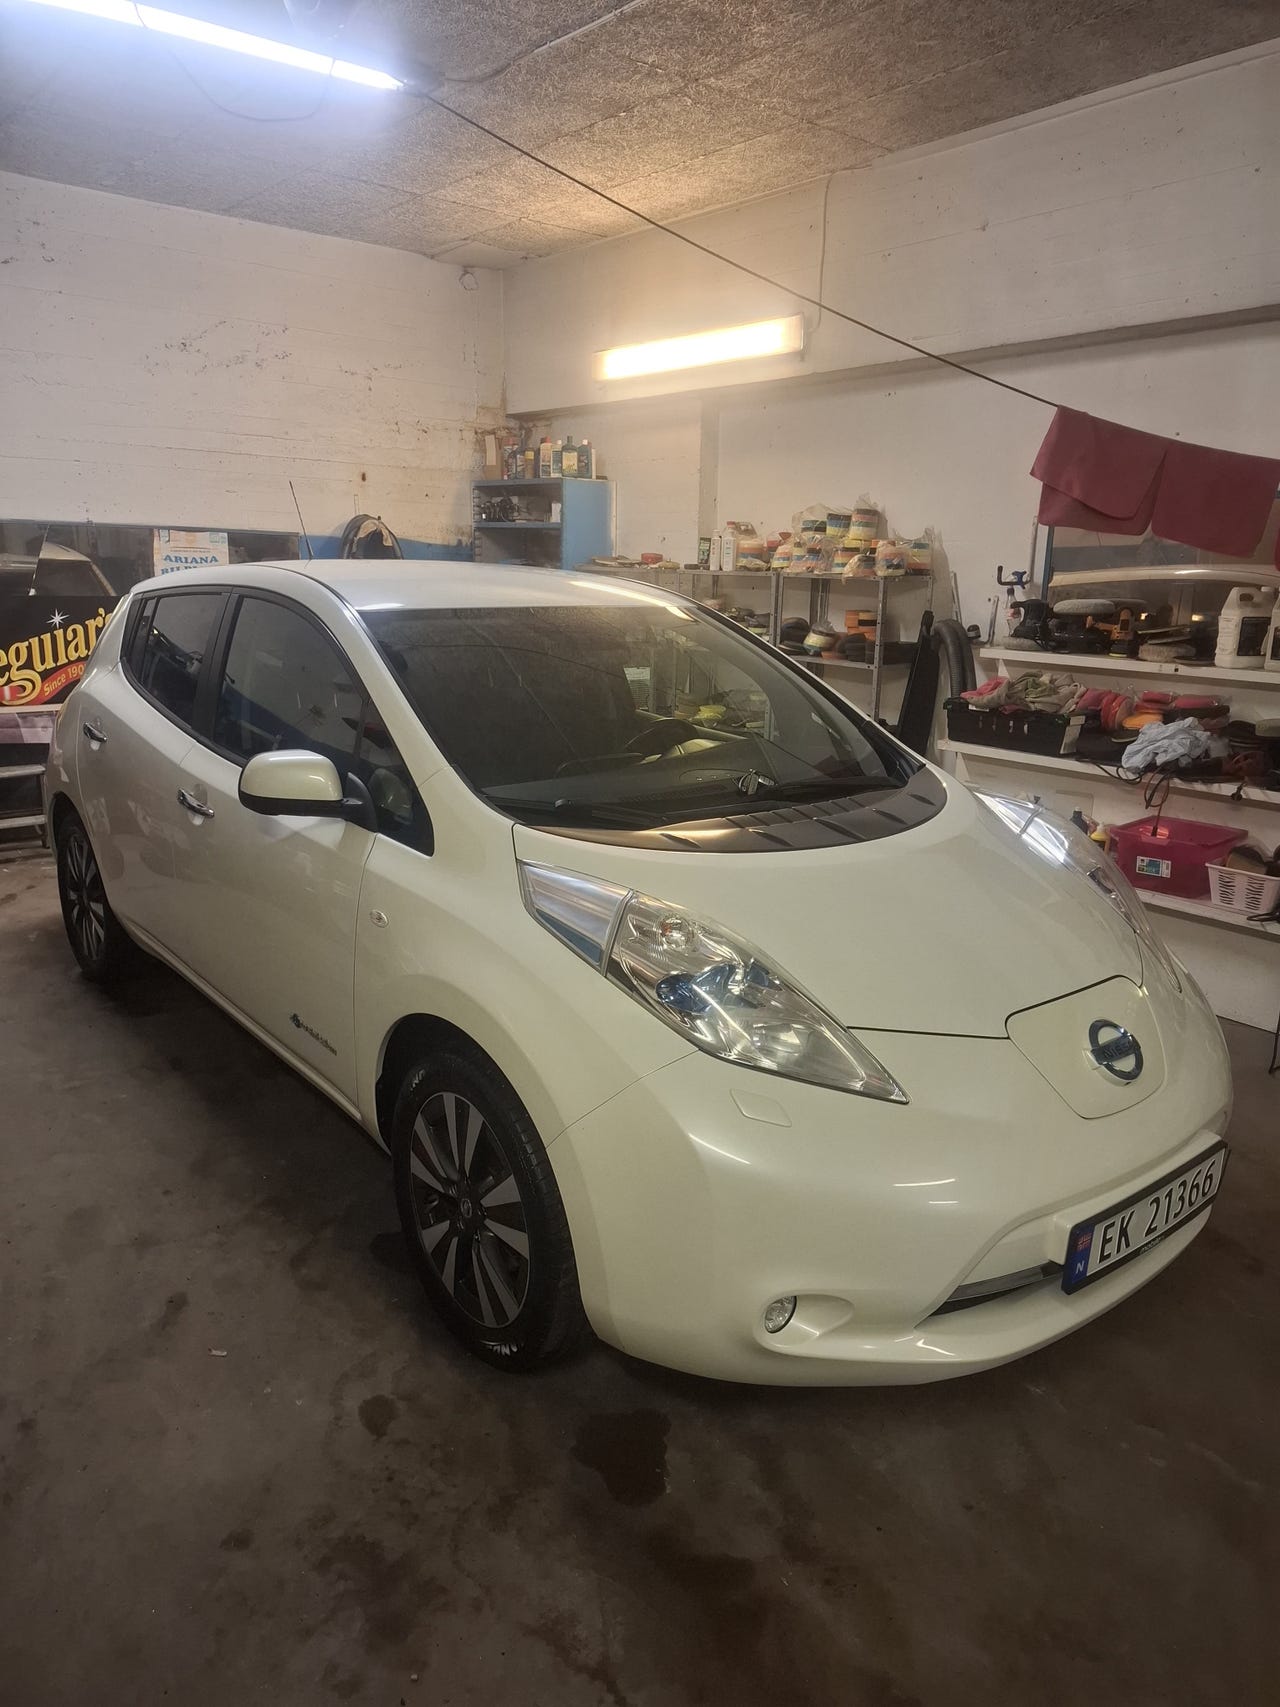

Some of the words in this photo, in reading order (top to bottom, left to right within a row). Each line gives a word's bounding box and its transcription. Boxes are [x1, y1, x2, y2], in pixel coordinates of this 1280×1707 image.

[164, 554, 219, 564] ARIANA
[44, 673, 66, 696] Since
[68, 663, 87, 678] 190
[1099, 1209, 1135, 1264] EK
[1145, 1159, 1216, 1238] 21366
[1075, 1260, 1085, 1275] N
